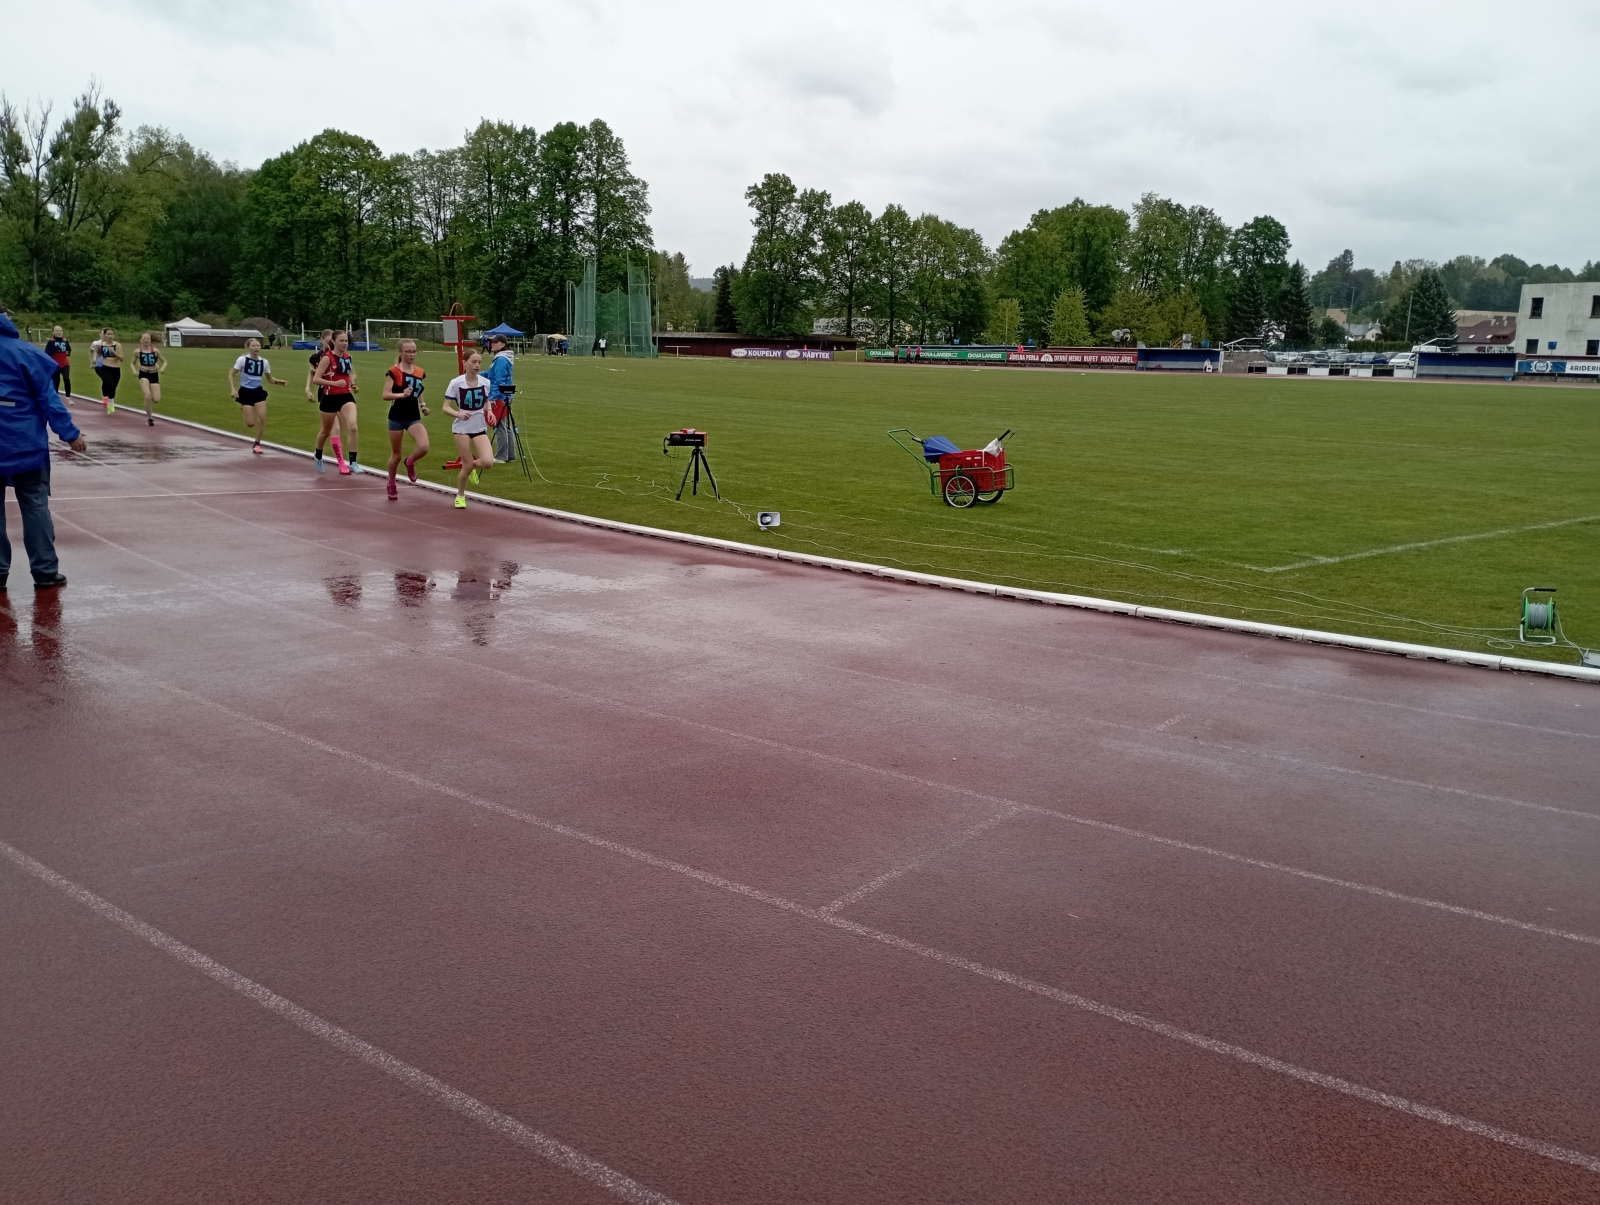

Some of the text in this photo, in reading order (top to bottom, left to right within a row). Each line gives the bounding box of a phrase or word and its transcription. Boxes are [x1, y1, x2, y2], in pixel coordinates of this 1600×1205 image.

[141, 354, 155, 365] 36
[802, 350, 830, 359] NÁBYTEK
[248, 360, 262, 375] 31
[464, 389, 484, 408] 45
